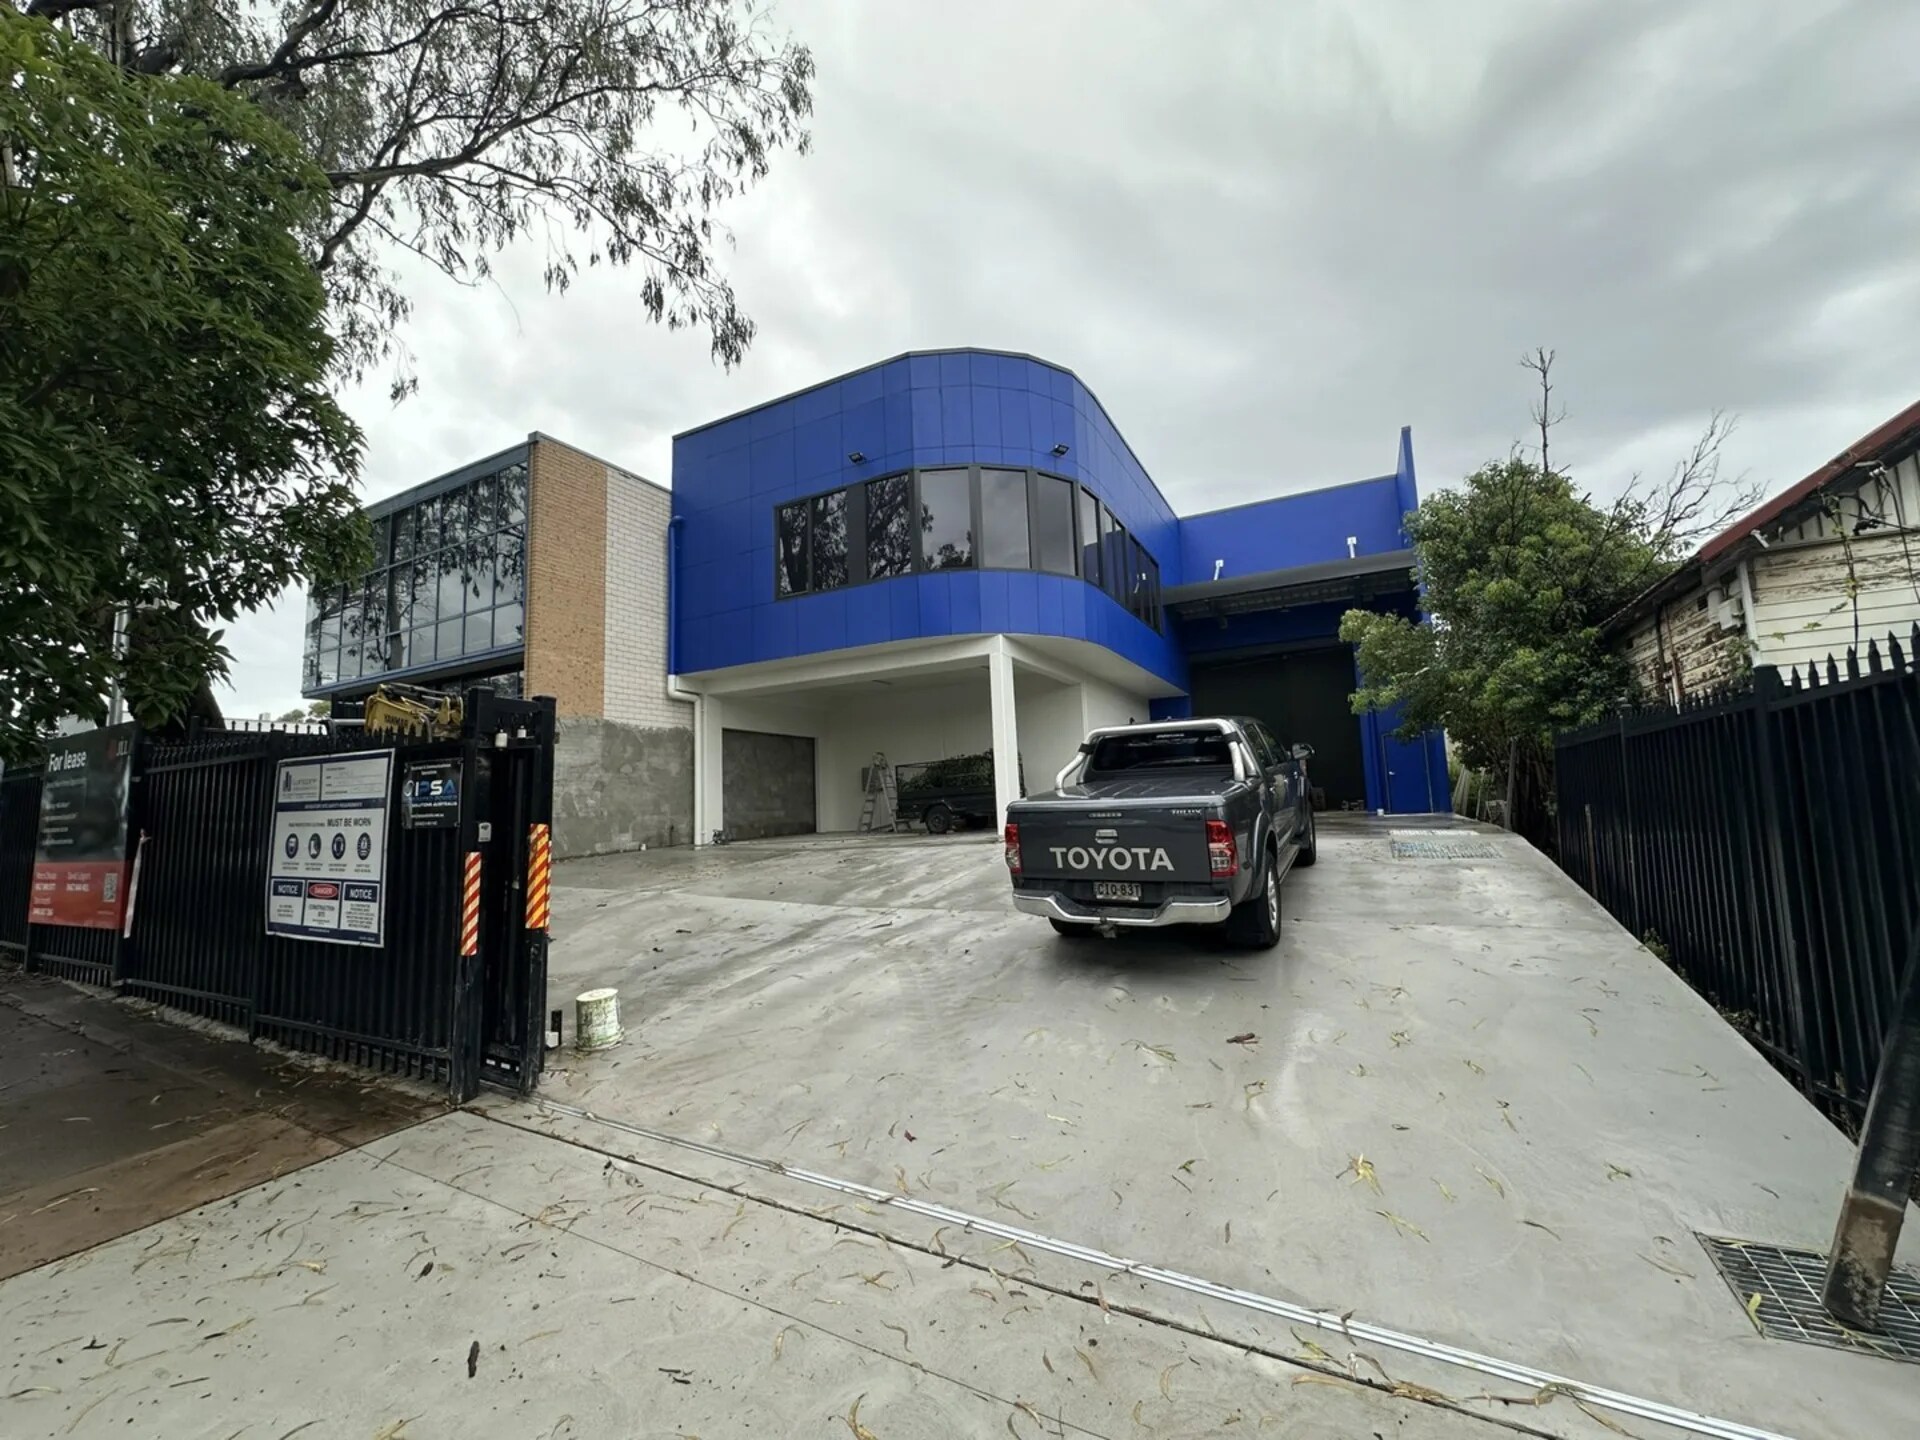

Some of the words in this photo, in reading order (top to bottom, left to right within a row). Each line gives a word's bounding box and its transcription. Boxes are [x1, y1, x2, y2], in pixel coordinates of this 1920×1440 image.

[48, 753, 64, 772] For
[64, 749, 87, 770] lease
[327, 818, 343, 828] MUST
[343, 818, 352, 828] BE
[353, 817, 372, 827] WORN
[1049, 847, 1175, 871] TOYOTA
[278, 884, 298, 895] NOTICE
[314, 886, 333, 895] DANGER
[350, 888, 373, 900] NOTICE
